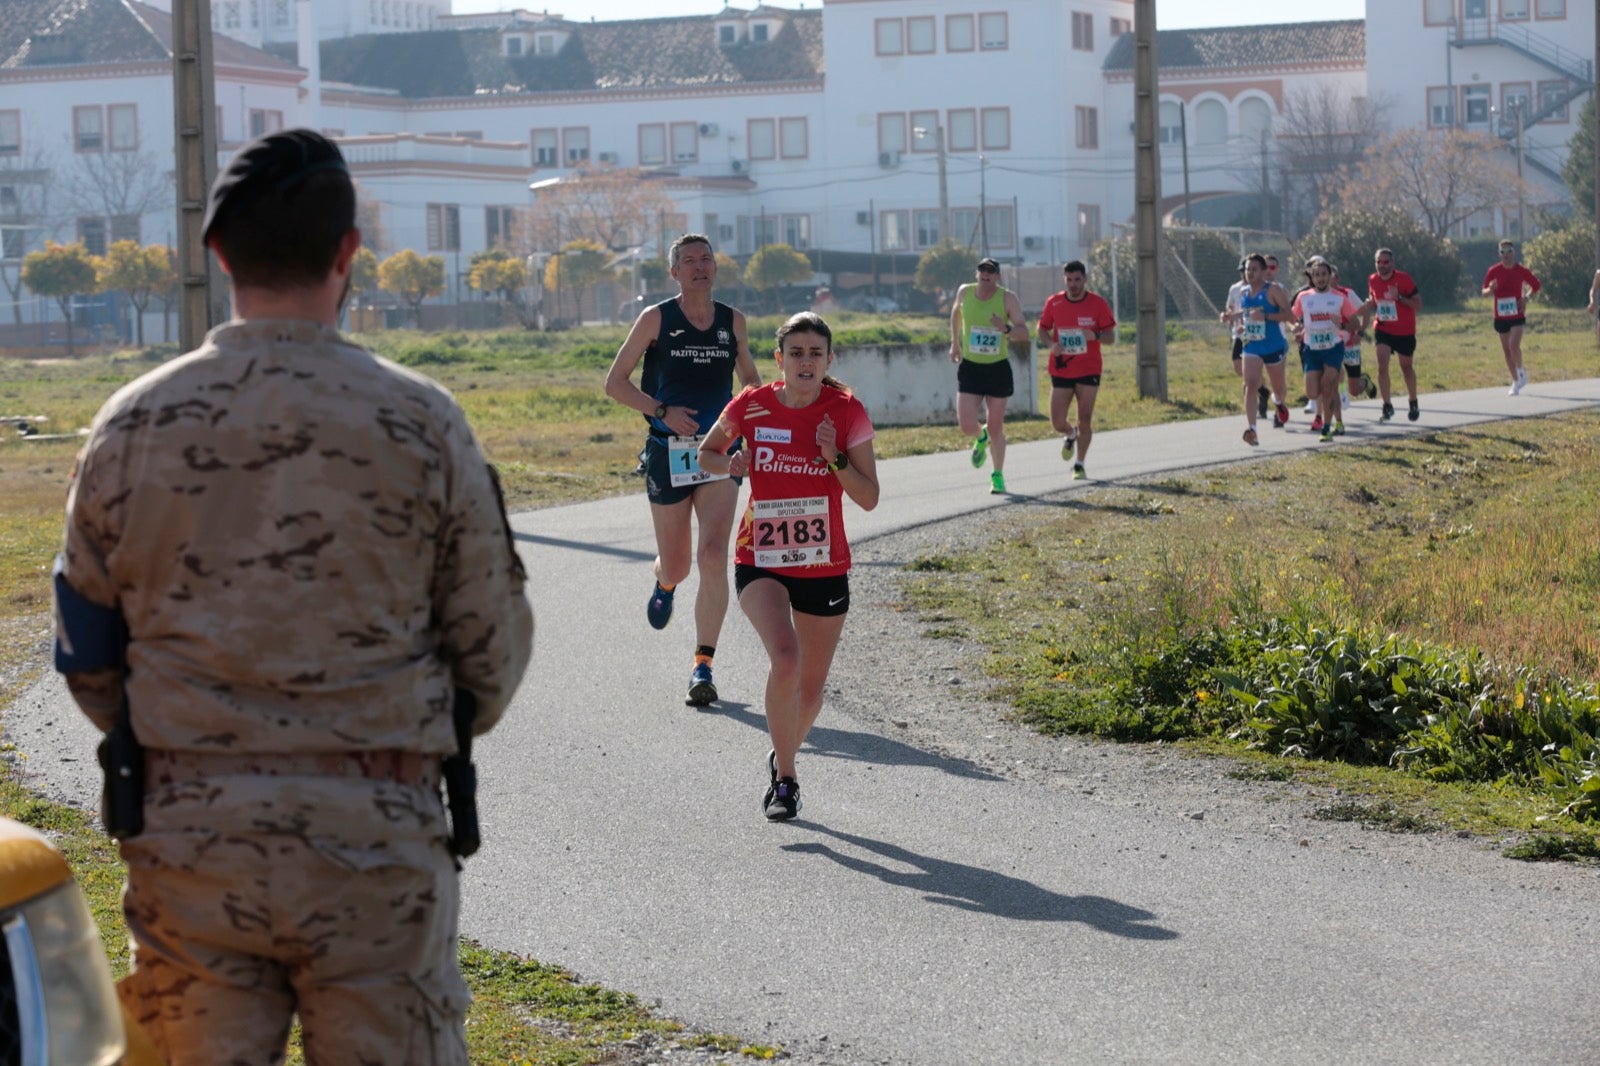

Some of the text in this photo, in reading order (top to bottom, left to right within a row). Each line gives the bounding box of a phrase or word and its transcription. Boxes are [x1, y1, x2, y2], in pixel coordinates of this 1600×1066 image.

[976, 335, 997, 346] 122
[1061, 336, 1082, 347] 768
[1314, 334, 1330, 343] 124
[670, 349, 699, 357] PAZITO
[705, 350, 730, 358] PAZITO
[777, 454, 807, 463] Clínicas
[770, 501, 784, 510] GRAN
[783, 500, 802, 509] PREMIO
[808, 498, 825, 506] FONDO
[758, 518, 827, 546] 2183
